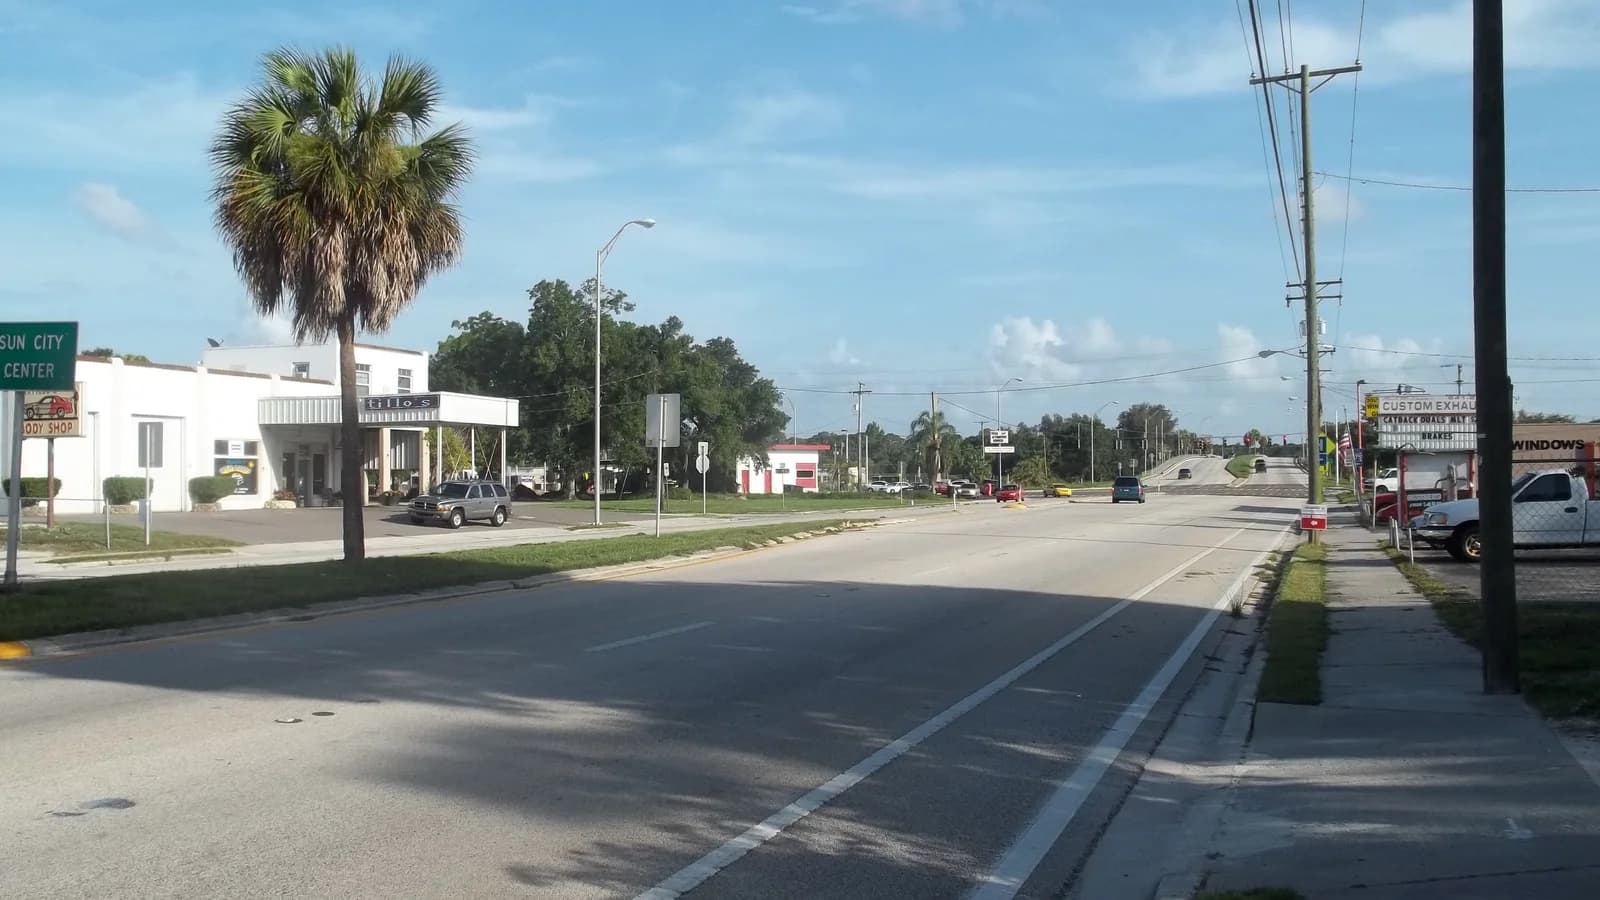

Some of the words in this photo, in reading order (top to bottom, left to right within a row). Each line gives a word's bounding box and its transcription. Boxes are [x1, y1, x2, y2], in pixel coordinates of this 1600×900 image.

[0, 335, 25, 350] SUN
[34, 335, 63, 350] CITY
[4, 363, 55, 378] CENTER
[1383, 401, 1432, 411] CUSTOM
[1421, 416, 1446, 424] DUALS
[22, 422, 44, 434] ODY
[49, 422, 73, 434] SHOP
[1422, 432, 1453, 440] BRAKES
[1512, 439, 1585, 451] WINDOWS
